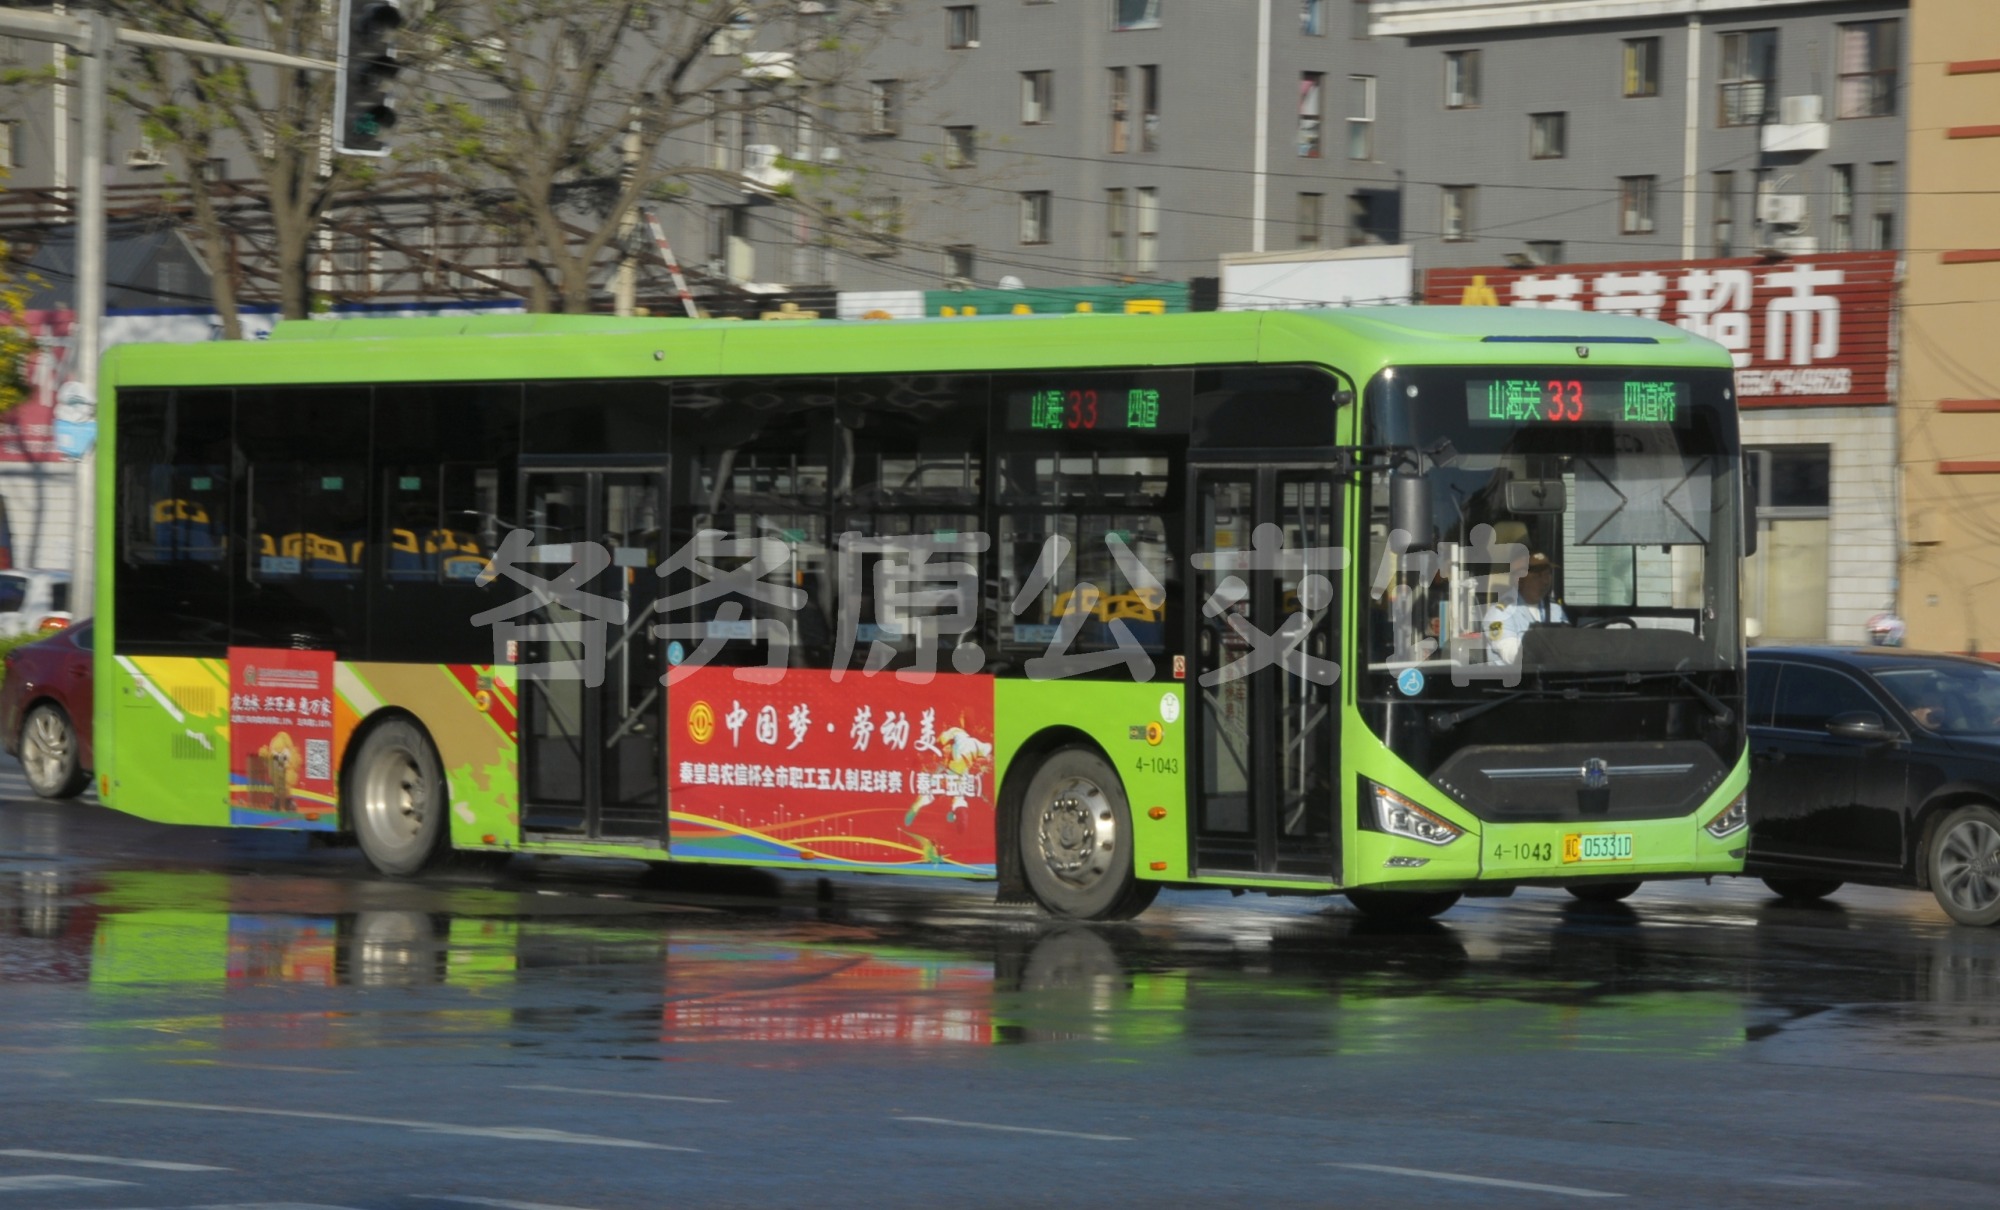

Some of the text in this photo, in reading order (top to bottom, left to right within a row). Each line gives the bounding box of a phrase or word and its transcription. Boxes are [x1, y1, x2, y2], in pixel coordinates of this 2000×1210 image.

[1068, 390, 1098, 429] 33
[1489, 380, 1676, 421] 山海关 33 四道桥
[1135, 756, 1178, 774] 4-1043
[1494, 843, 1552, 861] 4-1043
